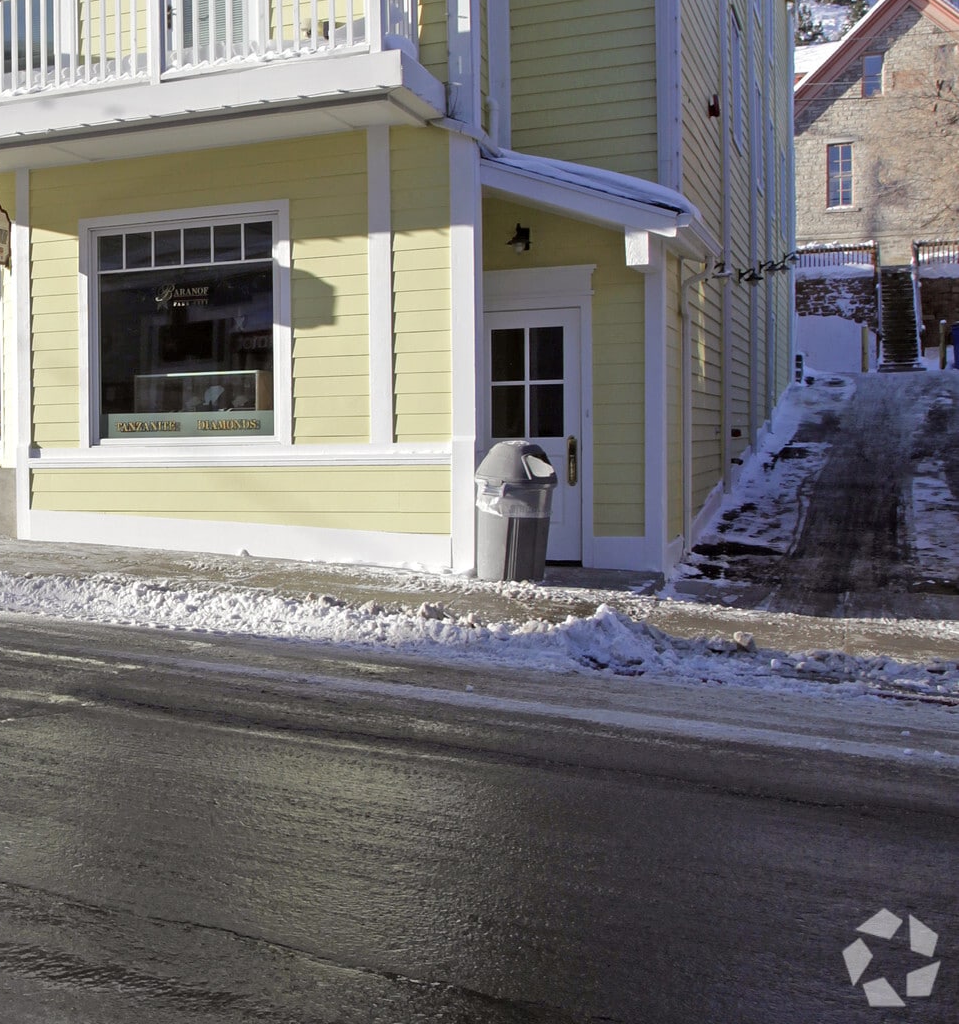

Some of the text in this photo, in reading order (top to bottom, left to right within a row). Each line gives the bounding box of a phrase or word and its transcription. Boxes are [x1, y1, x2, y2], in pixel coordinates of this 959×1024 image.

[155, 284, 209, 301] BARANOF
[116, 419, 261, 433] TANZANITE DIAMONDS
